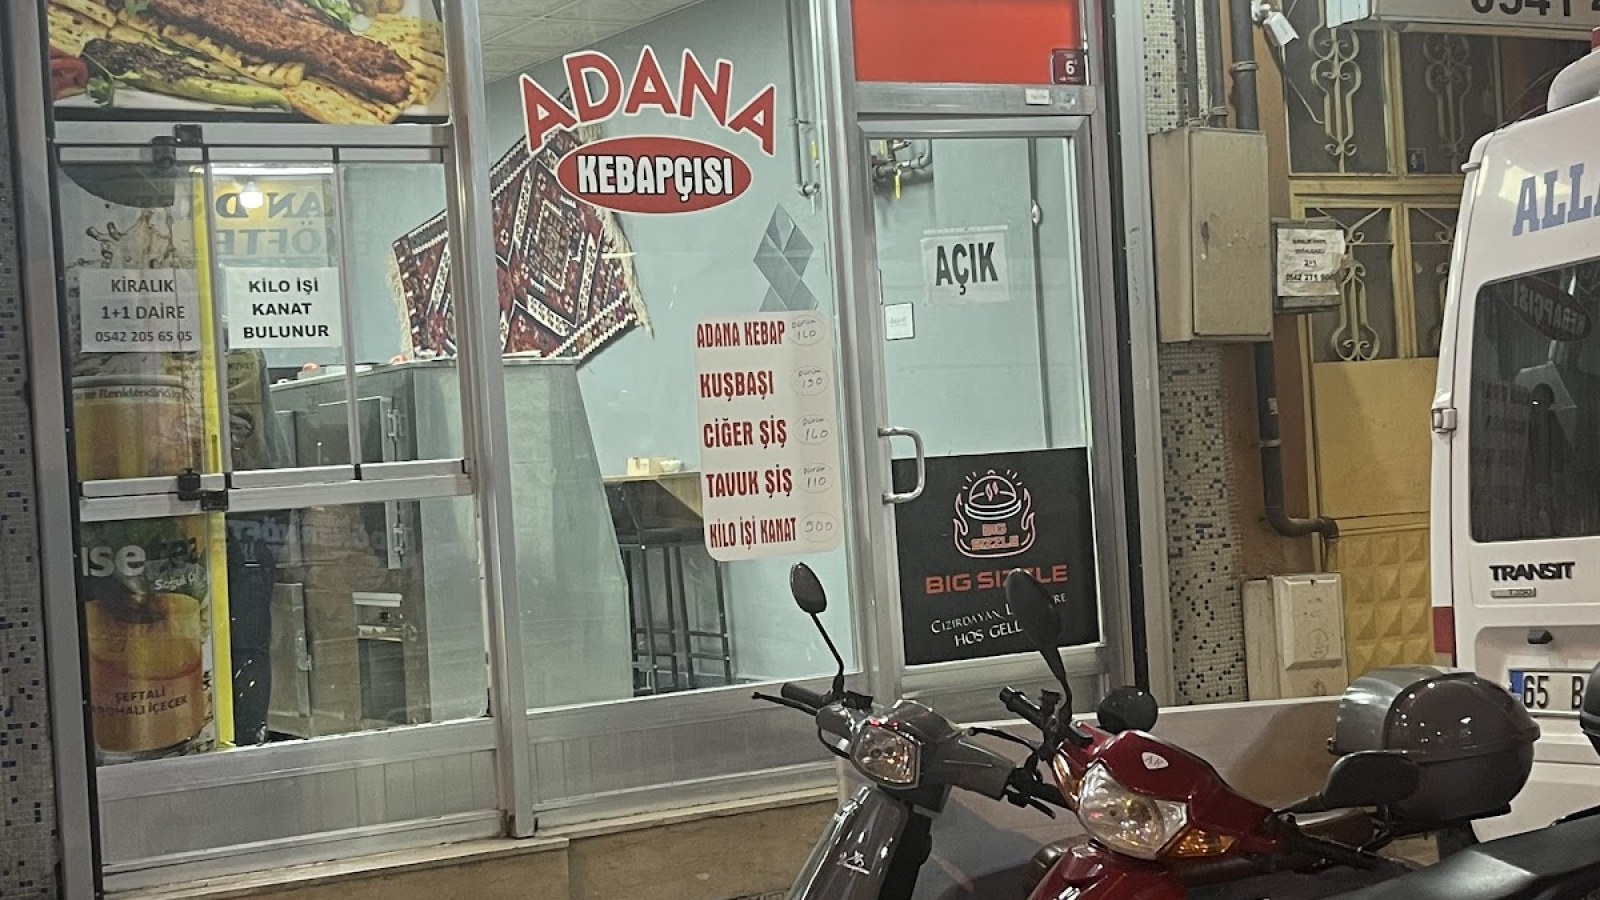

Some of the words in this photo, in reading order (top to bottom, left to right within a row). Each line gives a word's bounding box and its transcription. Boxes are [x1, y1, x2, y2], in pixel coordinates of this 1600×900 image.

[519, 45, 776, 157] ADANA
[576, 154, 734, 202] KEBAPÇISI
[1512, 163, 1600, 236] ALL
[935, 241, 999, 295] AÇIK
[111, 276, 175, 293] KİRALIK
[248, 278, 290, 293] KİLO
[296, 277, 319, 294] İŞİ
[101, 306, 131, 320] 1+1
[135, 302, 185, 320] DAİRE
[252, 303, 313, 316] KANAT
[95, 331, 127, 342] 0542
[131, 331, 154, 342] 205
[158, 331, 174, 342] 65
[176, 331, 193, 342] 05
[243, 325, 329, 339] BULUNUR
[696, 323, 741, 348] ADANA
[744, 320, 786, 346] KEBAP
[700, 370, 775, 402] KUŞBAŞI
[703, 417, 753, 449] CİĞER
[759, 414, 787, 449] ŞİŞ
[706, 470, 760, 498] TAVUK
[764, 464, 793, 498] ŞİŞ
[807, 476, 827, 488] 110
[709, 518, 736, 548] KİLO
[739, 515, 757, 550] İŞİ
[760, 517, 797, 544] KANAT
[926, 574, 972, 594] BIG
[976, 564, 1068, 590] SILE
[1489, 561, 1575, 581] TRANSIT
[954, 629, 985, 647] HOS
[1523, 675, 1550, 709] 65
